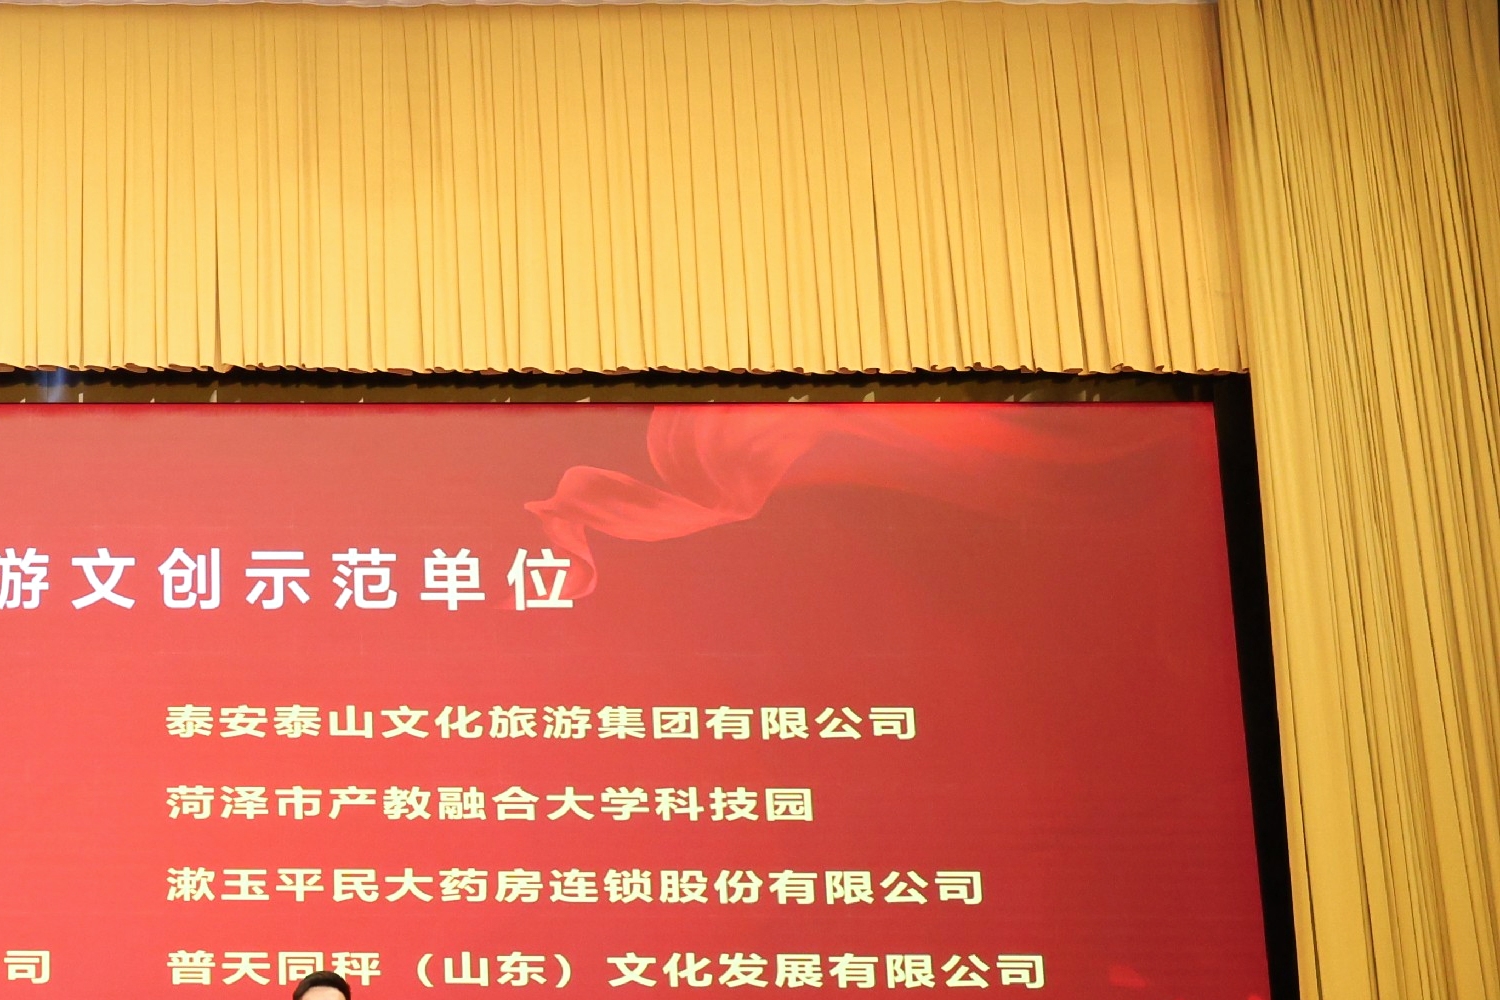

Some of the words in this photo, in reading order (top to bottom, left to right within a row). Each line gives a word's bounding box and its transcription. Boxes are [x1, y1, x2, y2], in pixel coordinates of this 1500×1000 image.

[165, 703, 917, 741] 泰安泰山文化旅游集团有限公司
[166, 784, 814, 822] 菏泽市产教融合大学科技园
[166, 866, 983, 905] 漱玉平民大药房连锁股份有限公司
